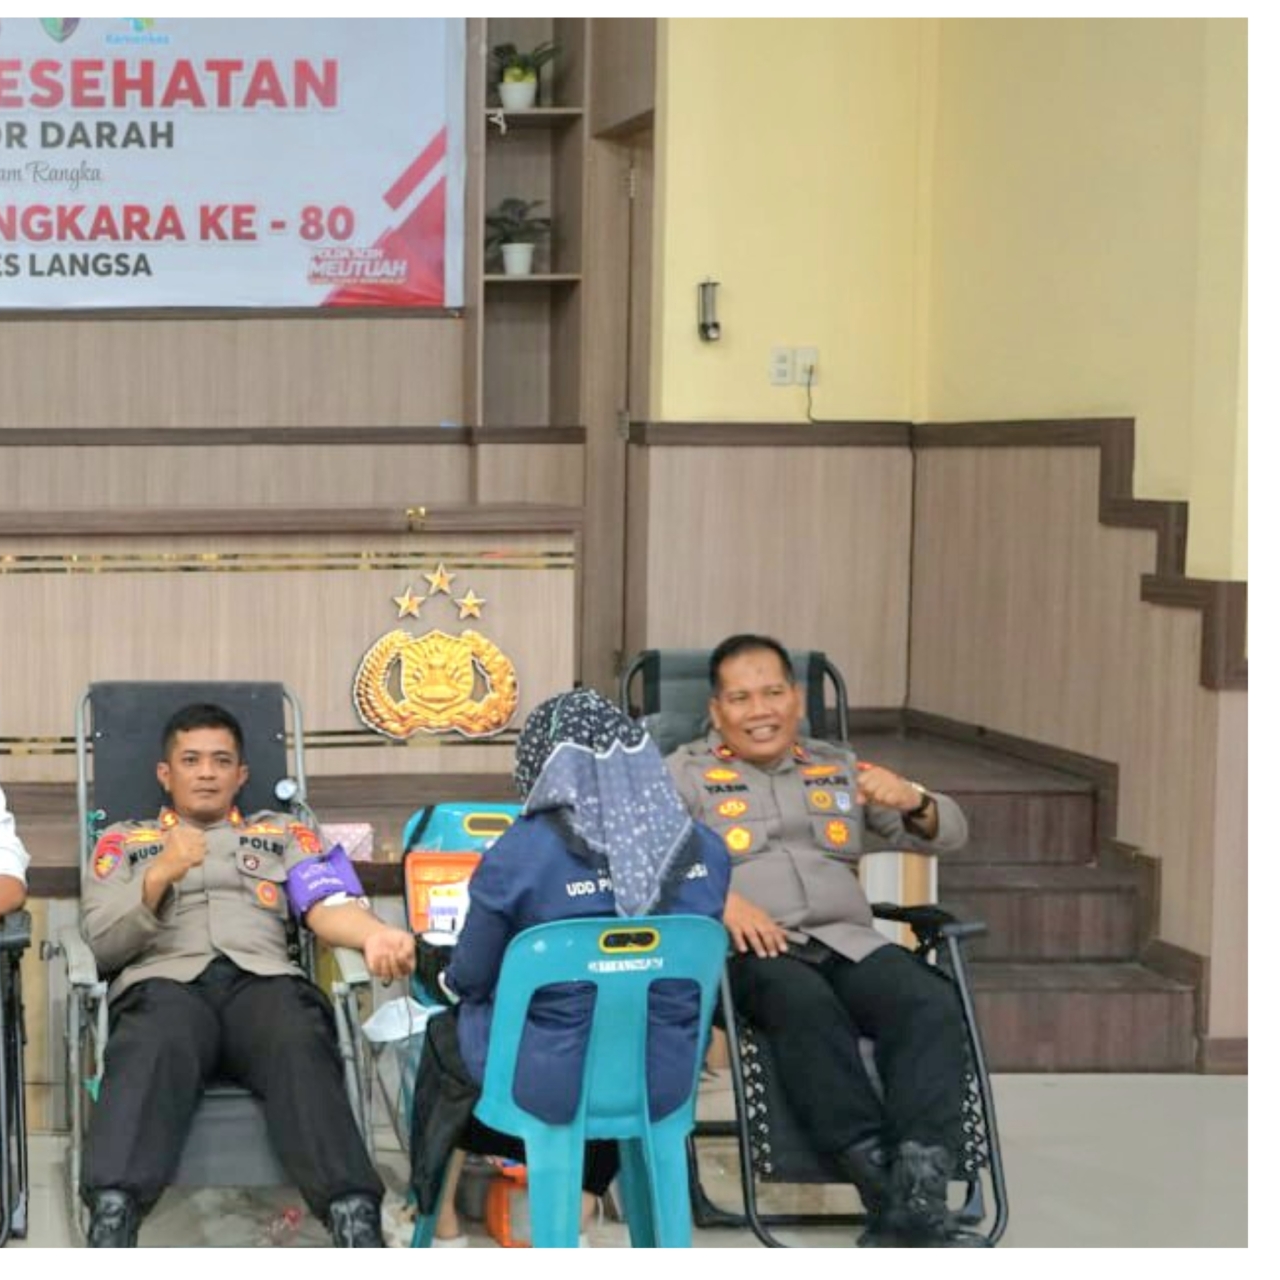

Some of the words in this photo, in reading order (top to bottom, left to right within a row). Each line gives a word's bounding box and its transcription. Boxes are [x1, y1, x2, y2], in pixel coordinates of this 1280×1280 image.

[40, 121, 174, 149] DARAH
[25, 160, 101, 190] Rangka
[199, 205, 257, 241] KE
[298, 205, 355, 241] 80
[28, 253, 153, 277] LANGSA
[565, 880, 597, 897] UDD
